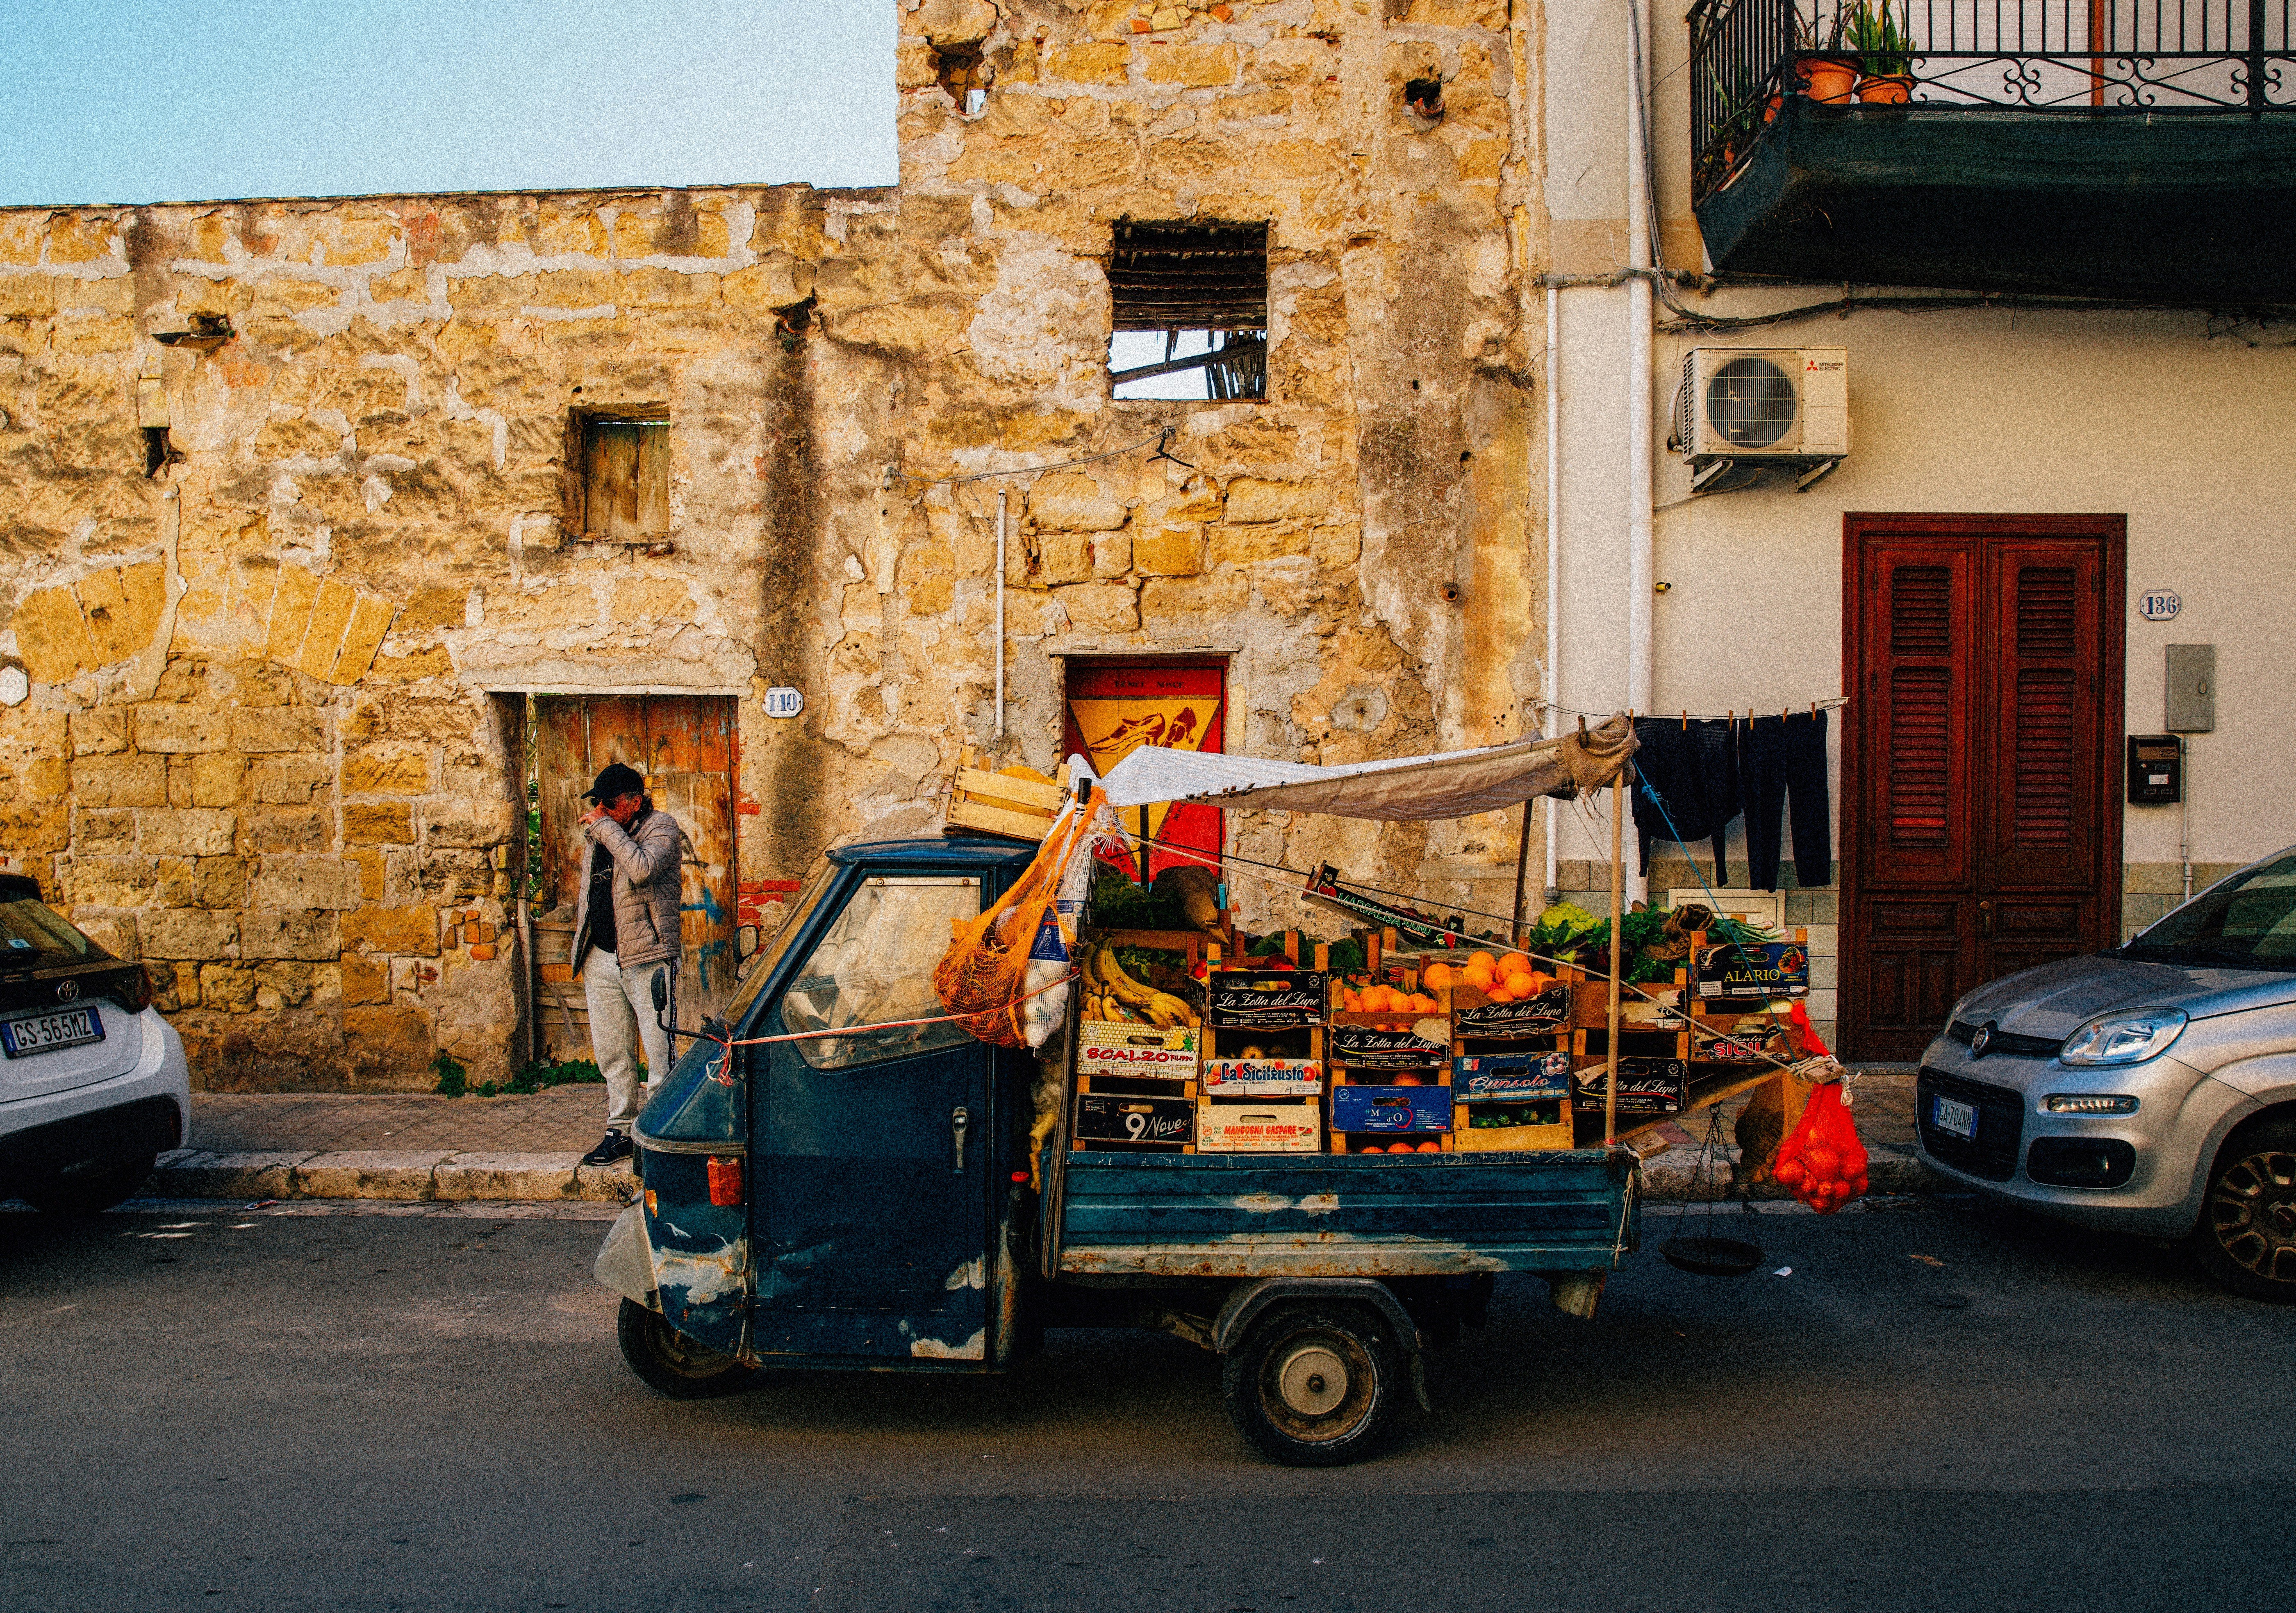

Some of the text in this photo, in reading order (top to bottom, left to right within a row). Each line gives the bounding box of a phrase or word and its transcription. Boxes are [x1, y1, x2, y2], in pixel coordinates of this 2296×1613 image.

[2146, 596, 2177, 614] 136
[769, 693, 797, 712] 140
[1724, 969, 1781, 982] ALARIO
[1217, 993, 1236, 1007] La
[1271, 993, 1293, 1006] del
[1289, 992, 1320, 1009] Lupo
[1462, 1007, 1481, 1019] La
[1515, 1004, 1536, 1017] del
[1532, 1003, 1562, 1019] Lupo
[1340, 1034, 1359, 1048] La
[1394, 1035, 1415, 1048] del
[1087, 1047, 1169, 1062] SCALZO
[1221, 1062, 1238, 1081] La
[1629, 1080, 1652, 1092] del
[1648, 1079, 1677, 1097] Lupo
[1126, 1113, 1184, 1141] 9 Nove
[1266, 1125, 1297, 1135] GASPARE
